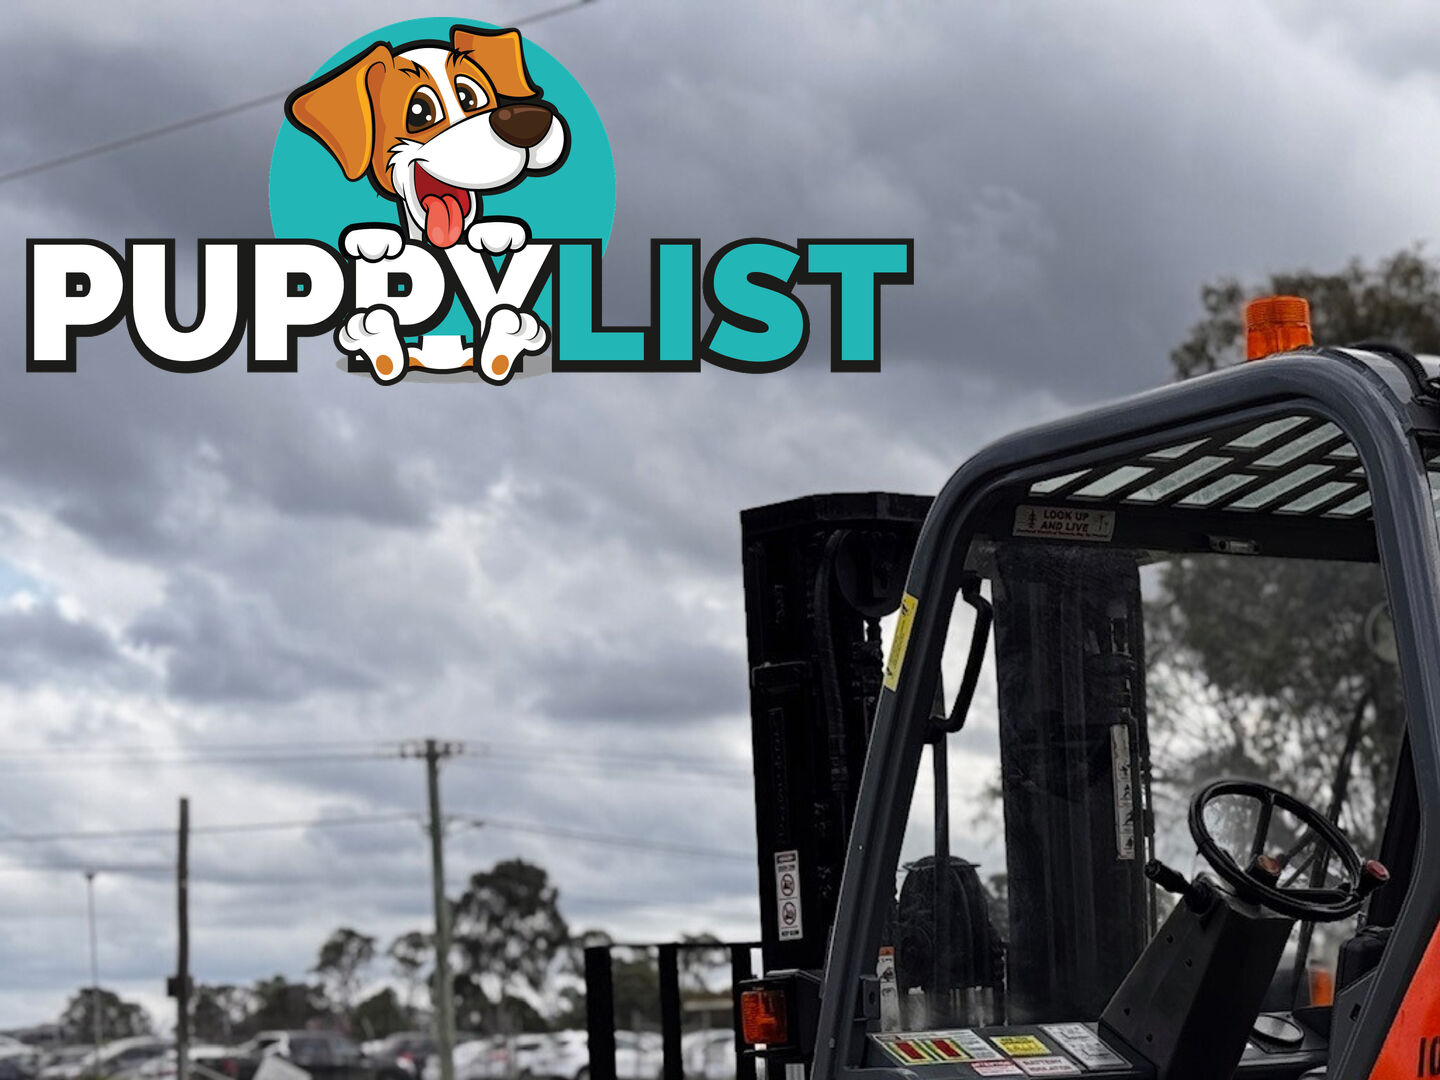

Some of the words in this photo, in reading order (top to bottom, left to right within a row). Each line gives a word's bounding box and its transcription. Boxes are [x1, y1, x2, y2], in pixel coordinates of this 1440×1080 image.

[1043, 510, 1073, 520] LOOK
[1075, 512, 1089, 521] UP
[1040, 521, 1063, 530] AND
[1065, 523, 1089, 532] LIVE
